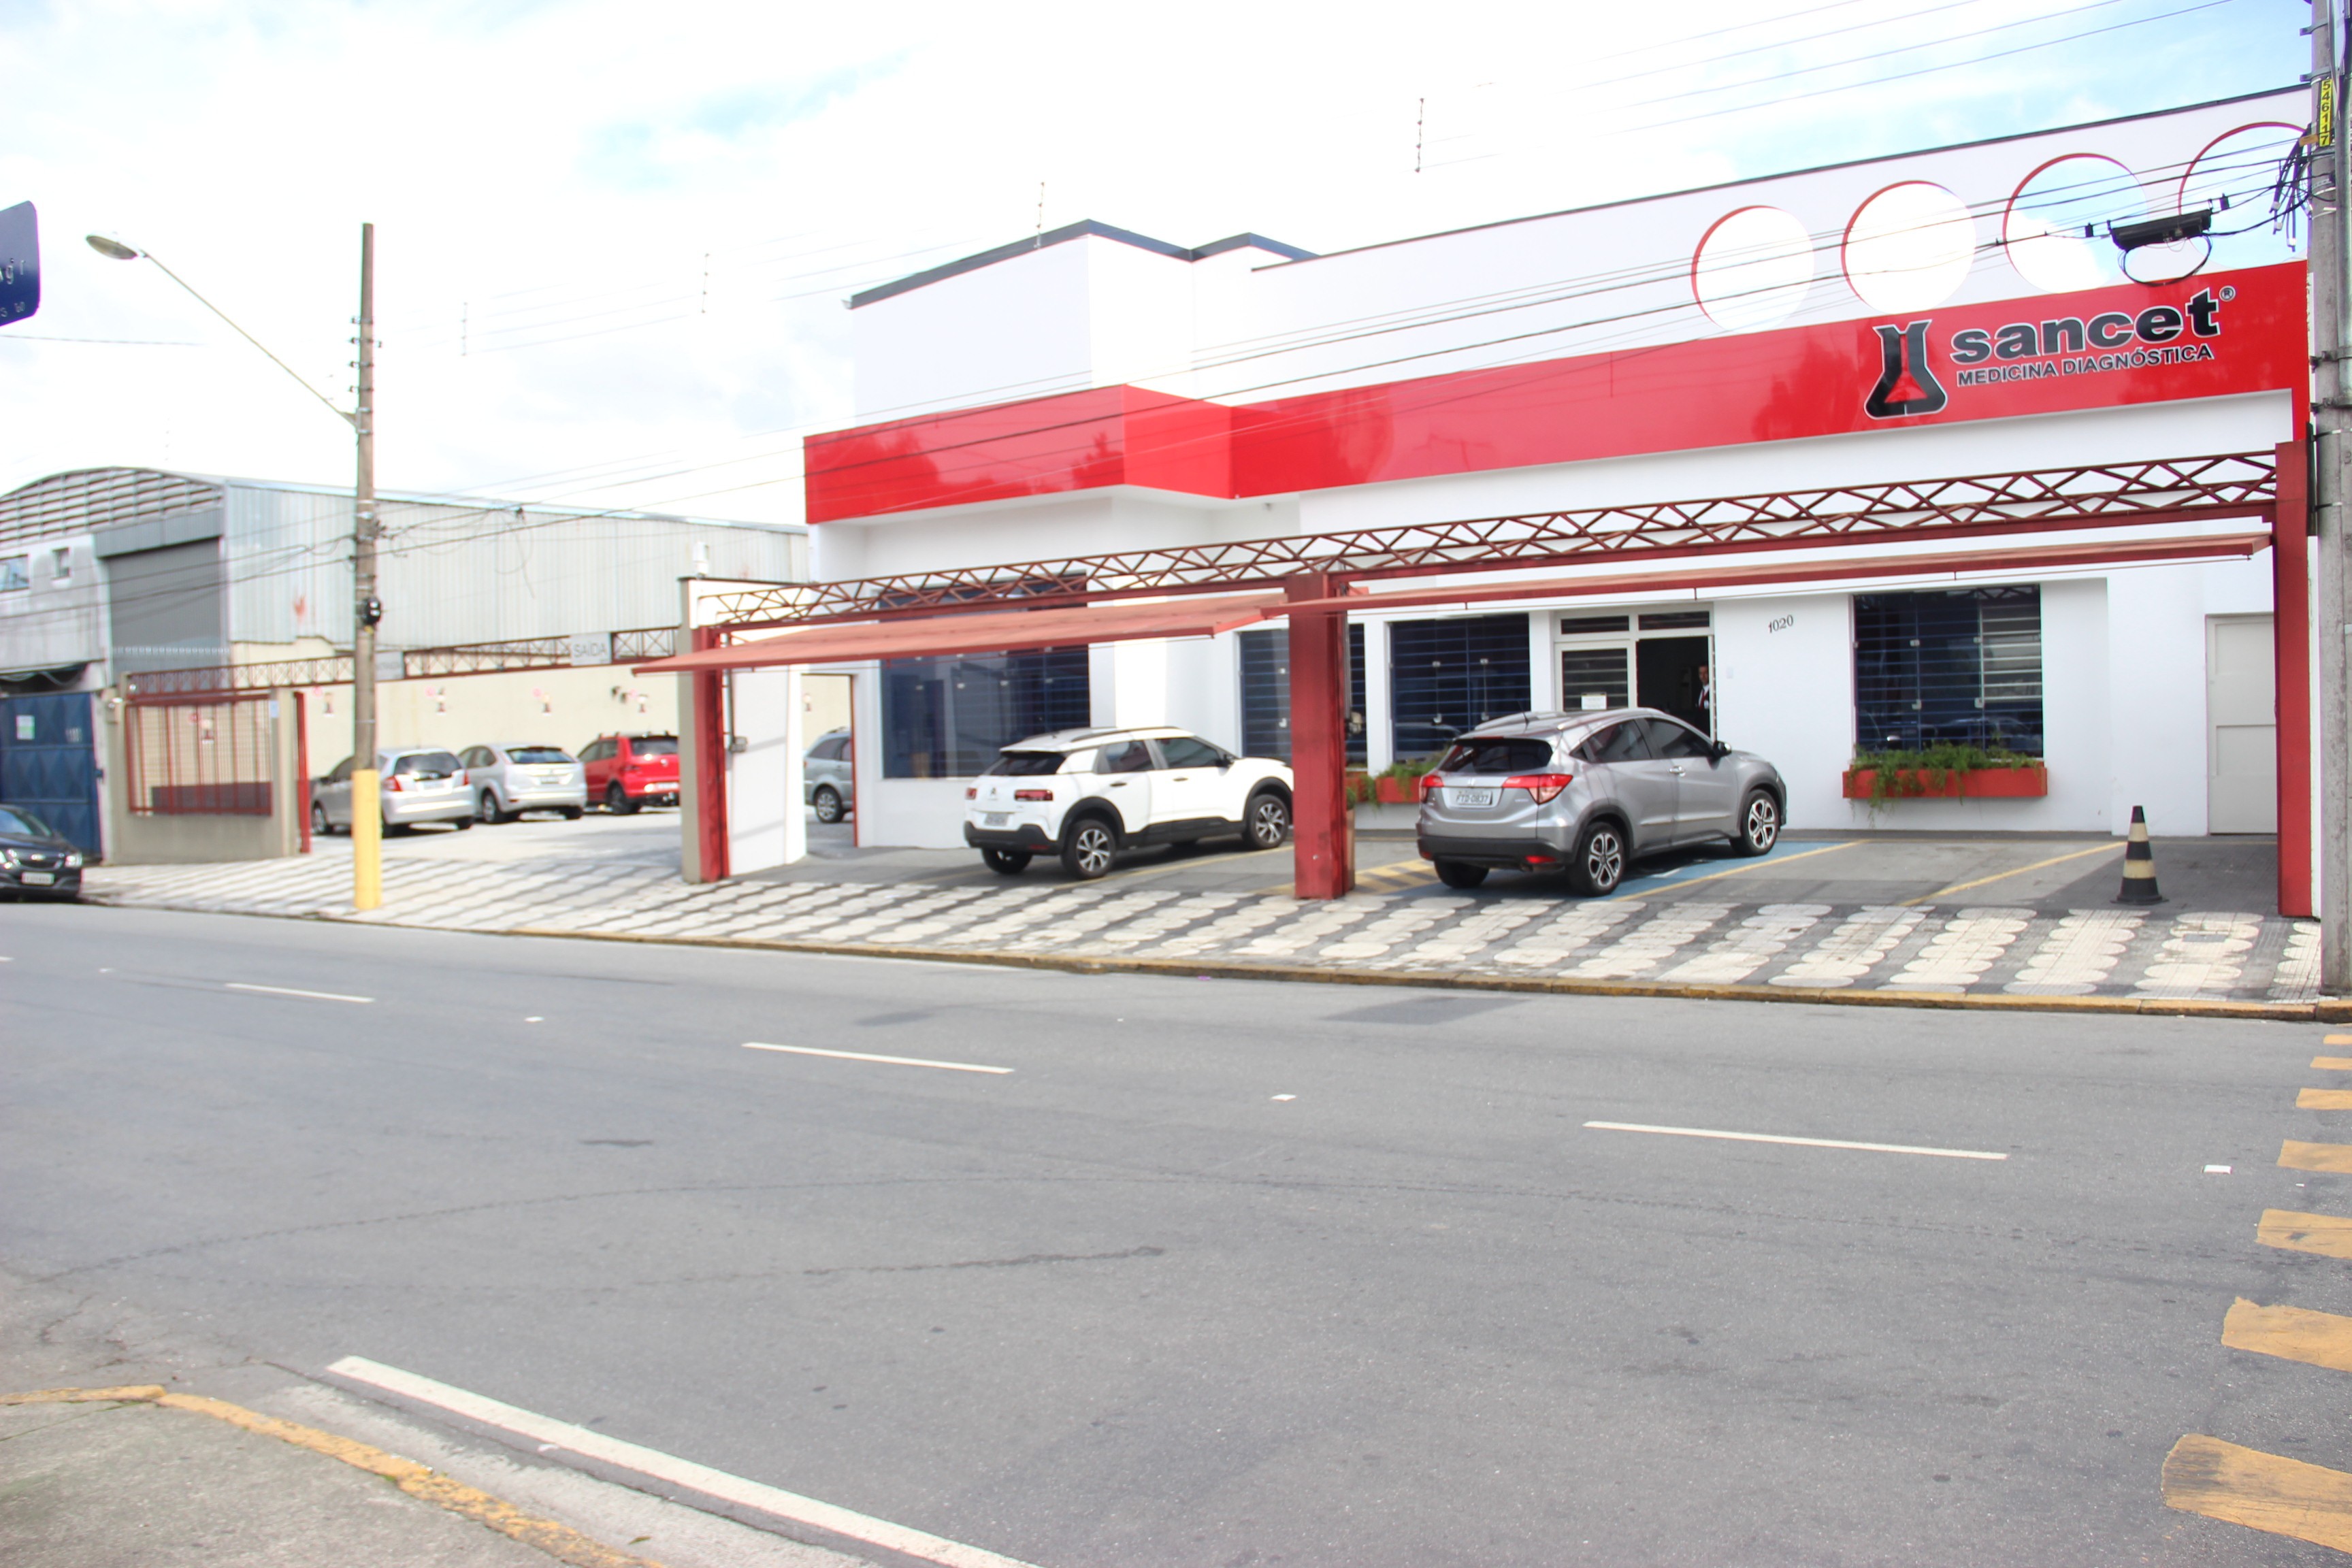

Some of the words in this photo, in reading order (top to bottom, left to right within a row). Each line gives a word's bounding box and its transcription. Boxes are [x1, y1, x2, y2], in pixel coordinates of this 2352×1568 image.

[2321, 80, 2331, 146] 546117
[1957, 360, 2059, 387] MEDICINA
[2062, 343, 2214, 375] DIAGNÓSTICA
[1768, 615, 1793, 633] 1020
